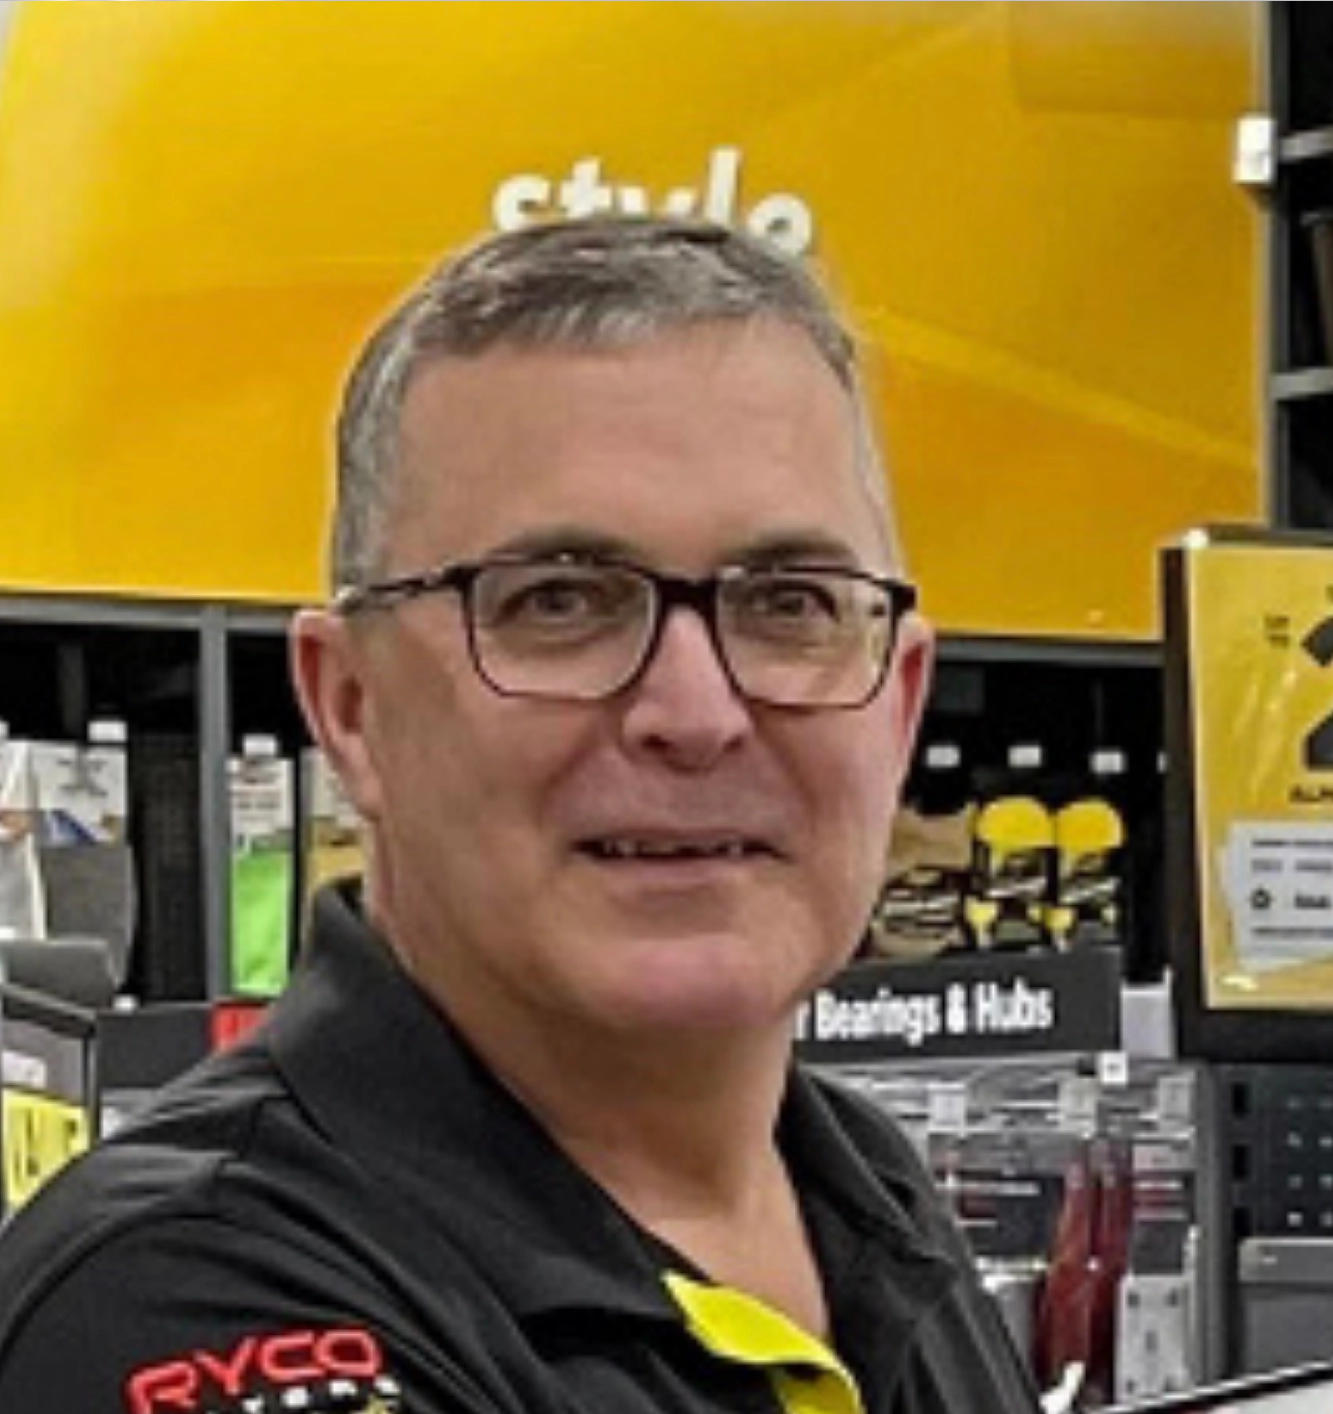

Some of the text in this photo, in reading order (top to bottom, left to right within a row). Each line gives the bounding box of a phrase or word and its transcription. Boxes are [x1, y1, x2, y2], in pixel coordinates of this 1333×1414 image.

[815, 987, 941, 1046] Bearings
[944, 982, 967, 1034] &
[974, 976, 1054, 1032] Hubs
